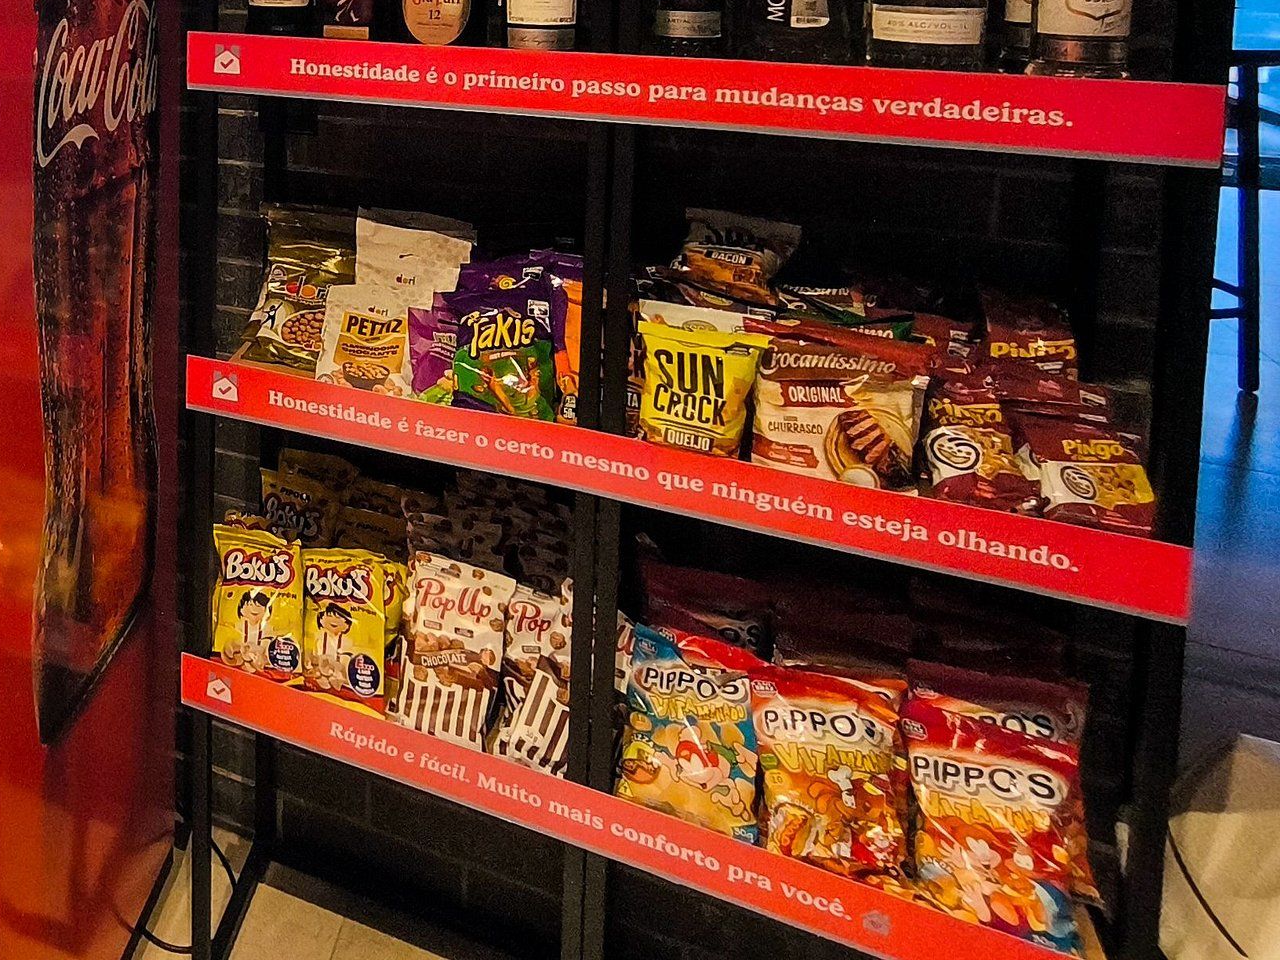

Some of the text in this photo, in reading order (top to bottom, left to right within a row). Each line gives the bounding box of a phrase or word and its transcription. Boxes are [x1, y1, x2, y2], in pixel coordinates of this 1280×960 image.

[428, 9, 441, 20] 12
[291, 59, 1072, 126] Honestidade é o primeiro passo para mudanças verdadeiras.
[711, 251, 747, 265] BACON
[347, 315, 403, 337] PETTIZ
[468, 311, 536, 359] Takis
[654, 349, 724, 399] SUN
[653, 383, 727, 427] CROCK
[788, 386, 845, 403] ORIGINAL
[768, 422, 823, 435] CHURRASCO
[666, 430, 711, 452] QUEIJO
[268, 390, 1079, 573] Honestidade é fazer o certo mesmo que ninguém esteja olhando.
[421, 652, 467, 667] CHOCOLATE
[329, 721, 852, 921] Rápido e fácil. Muito mais conforto pra você.
